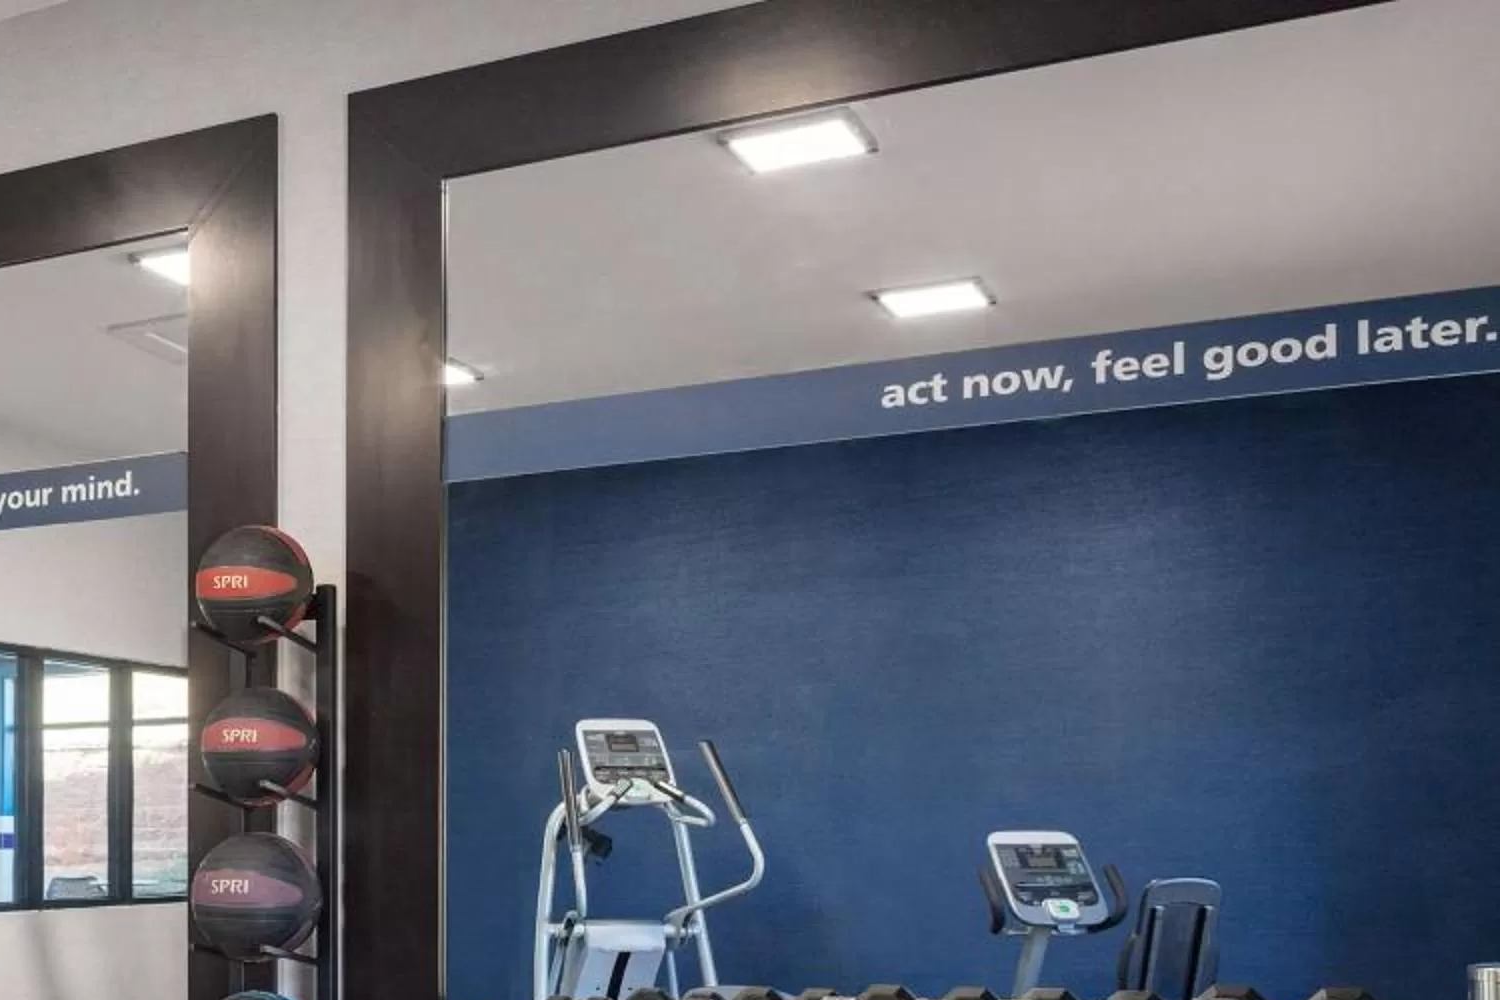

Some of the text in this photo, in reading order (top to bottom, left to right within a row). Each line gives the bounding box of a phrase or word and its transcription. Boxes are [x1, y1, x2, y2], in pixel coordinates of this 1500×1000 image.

[880, 314, 1498, 409] act now, feel good later.
[60, 470, 141, 505] mind.
[212, 574, 249, 590] SPRI
[221, 727, 258, 744] SPRI
[211, 878, 249, 896] SPRI
